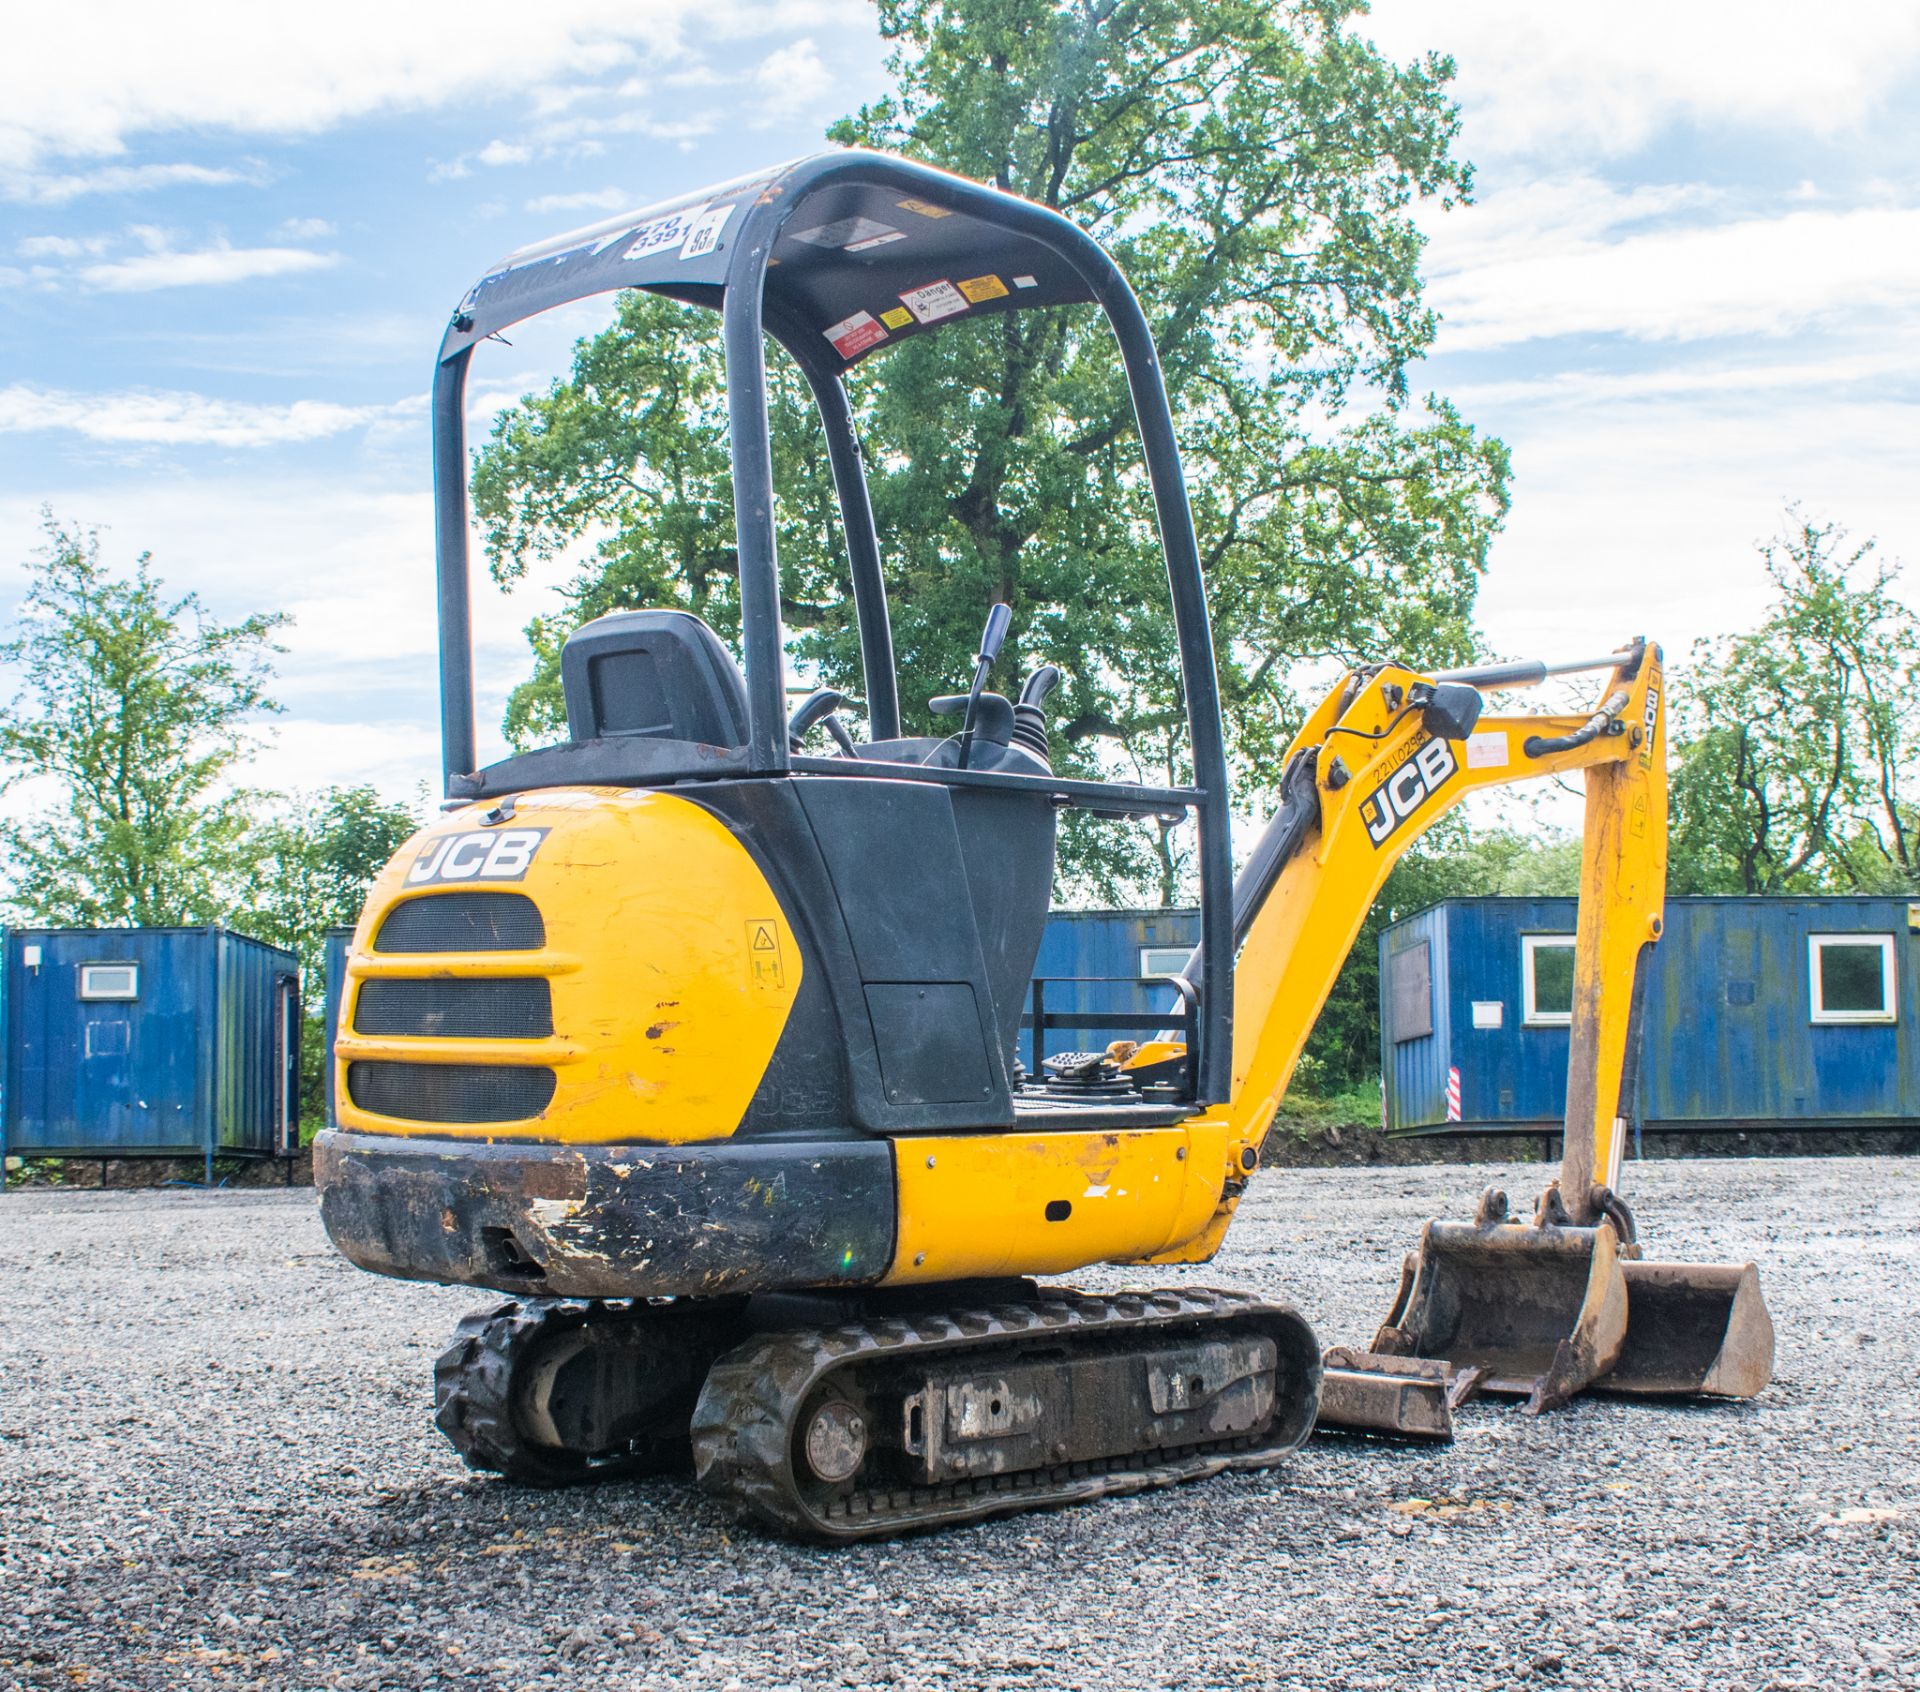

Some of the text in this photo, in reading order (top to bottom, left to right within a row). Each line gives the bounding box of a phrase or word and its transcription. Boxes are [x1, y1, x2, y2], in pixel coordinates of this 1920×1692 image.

[633, 223, 692, 251] 3391
[690, 227, 713, 253] 93
[917, 284, 951, 299] Danger
[1373, 730, 1427, 784] 22110298
[1369, 737, 1454, 841] JCB
[408, 831, 542, 882] JCB
[756, 1087, 838, 1116] JCB
